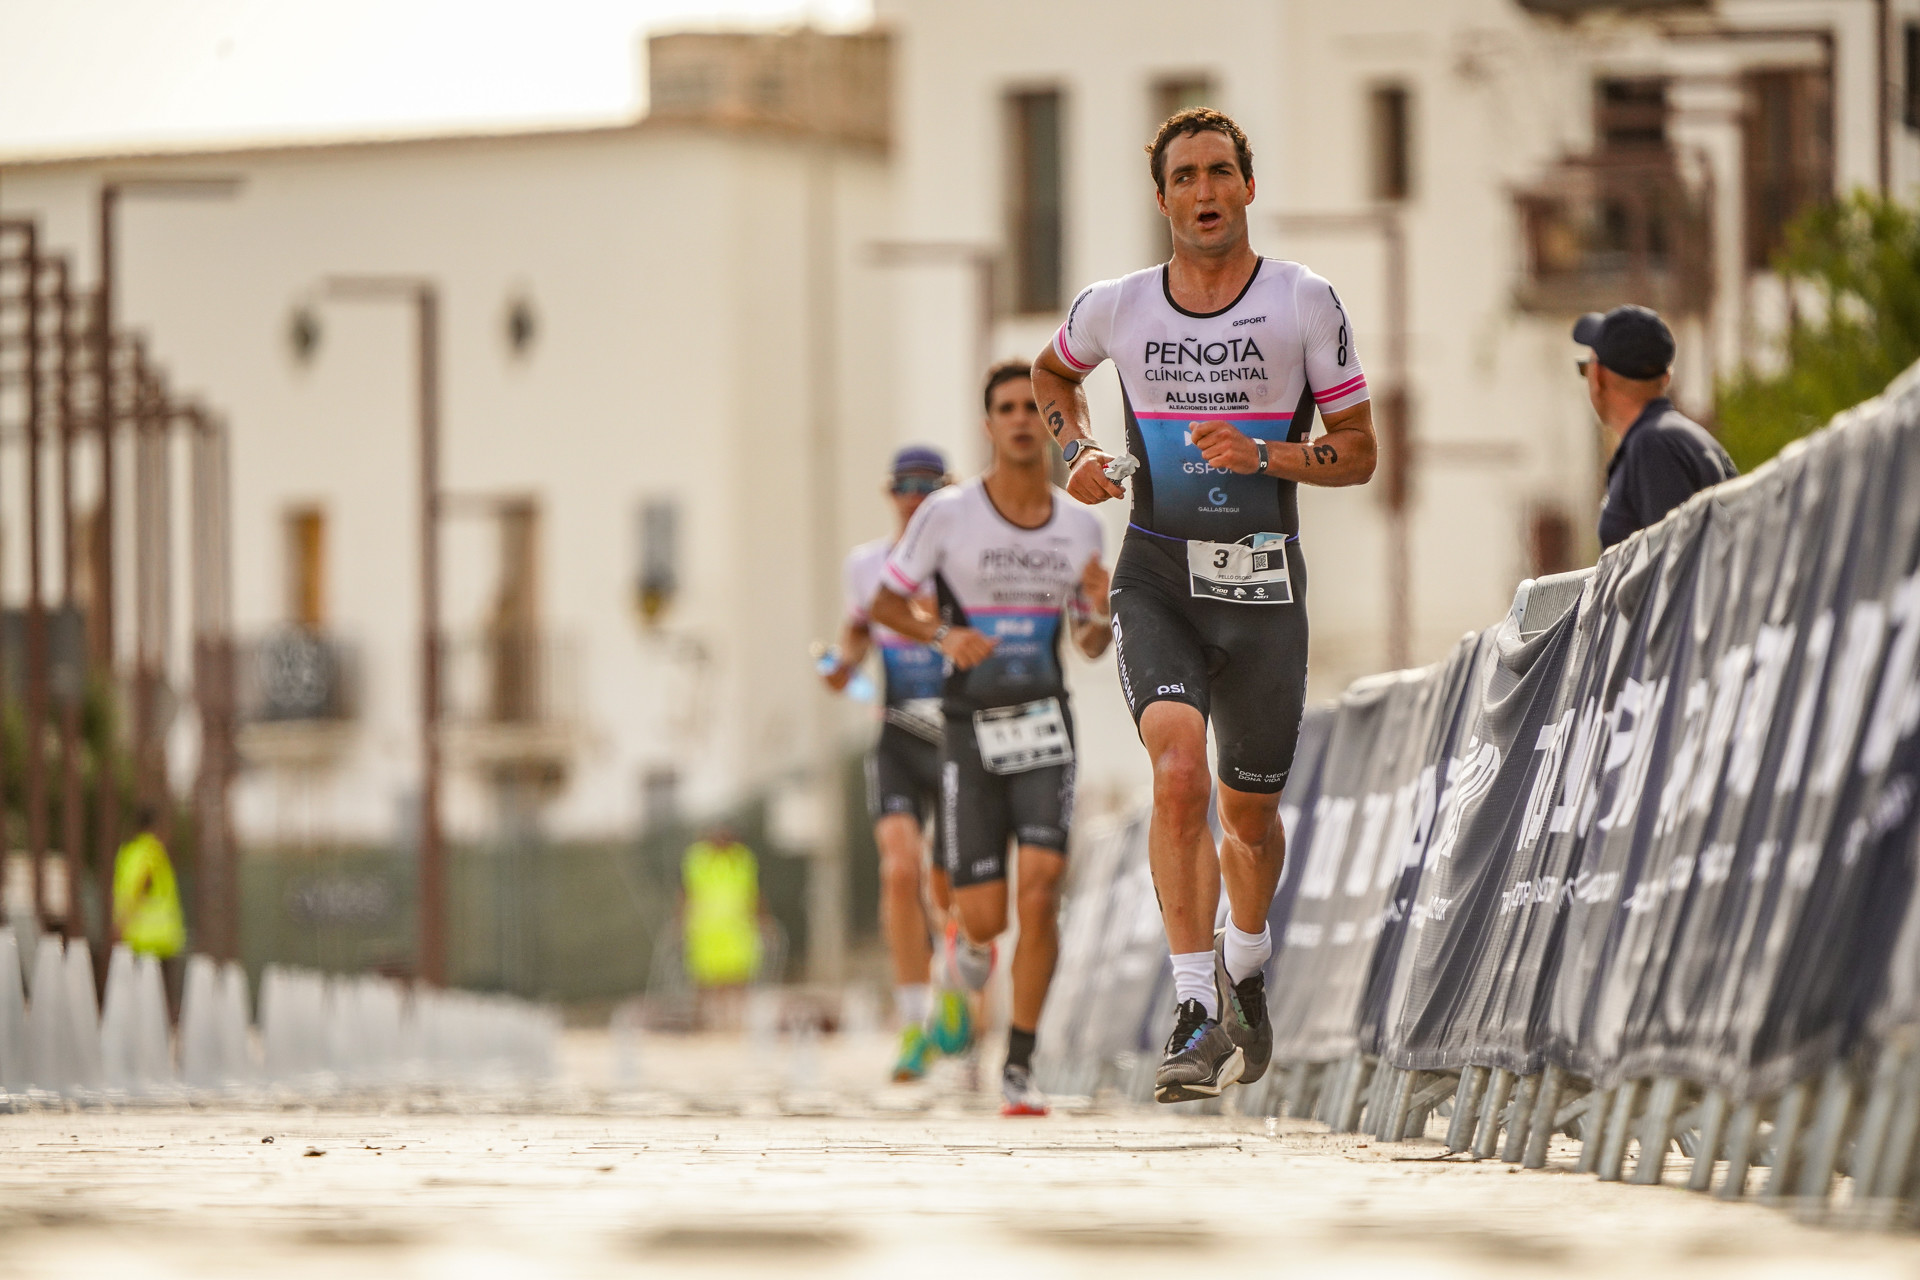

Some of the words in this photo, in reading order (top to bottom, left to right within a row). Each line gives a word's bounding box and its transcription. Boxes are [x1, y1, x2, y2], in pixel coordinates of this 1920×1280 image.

[1232, 315, 1267, 327] GSPORT
[1144, 336, 1265, 366] PEÑOTA
[1144, 367, 1206, 383] CLÍNICA
[1210, 367, 1269, 382] DENTAL
[1165, 391, 1250, 403] ALUSIGMA
[1048, 410, 1065, 437] 3
[1313, 444, 1338, 465] 3
[1183, 462, 1233, 475] GSPO
[1213, 548, 1230, 569] 3
[1238, 774, 1261, 783] DONA
[1239, 770, 1263, 779] DONA
